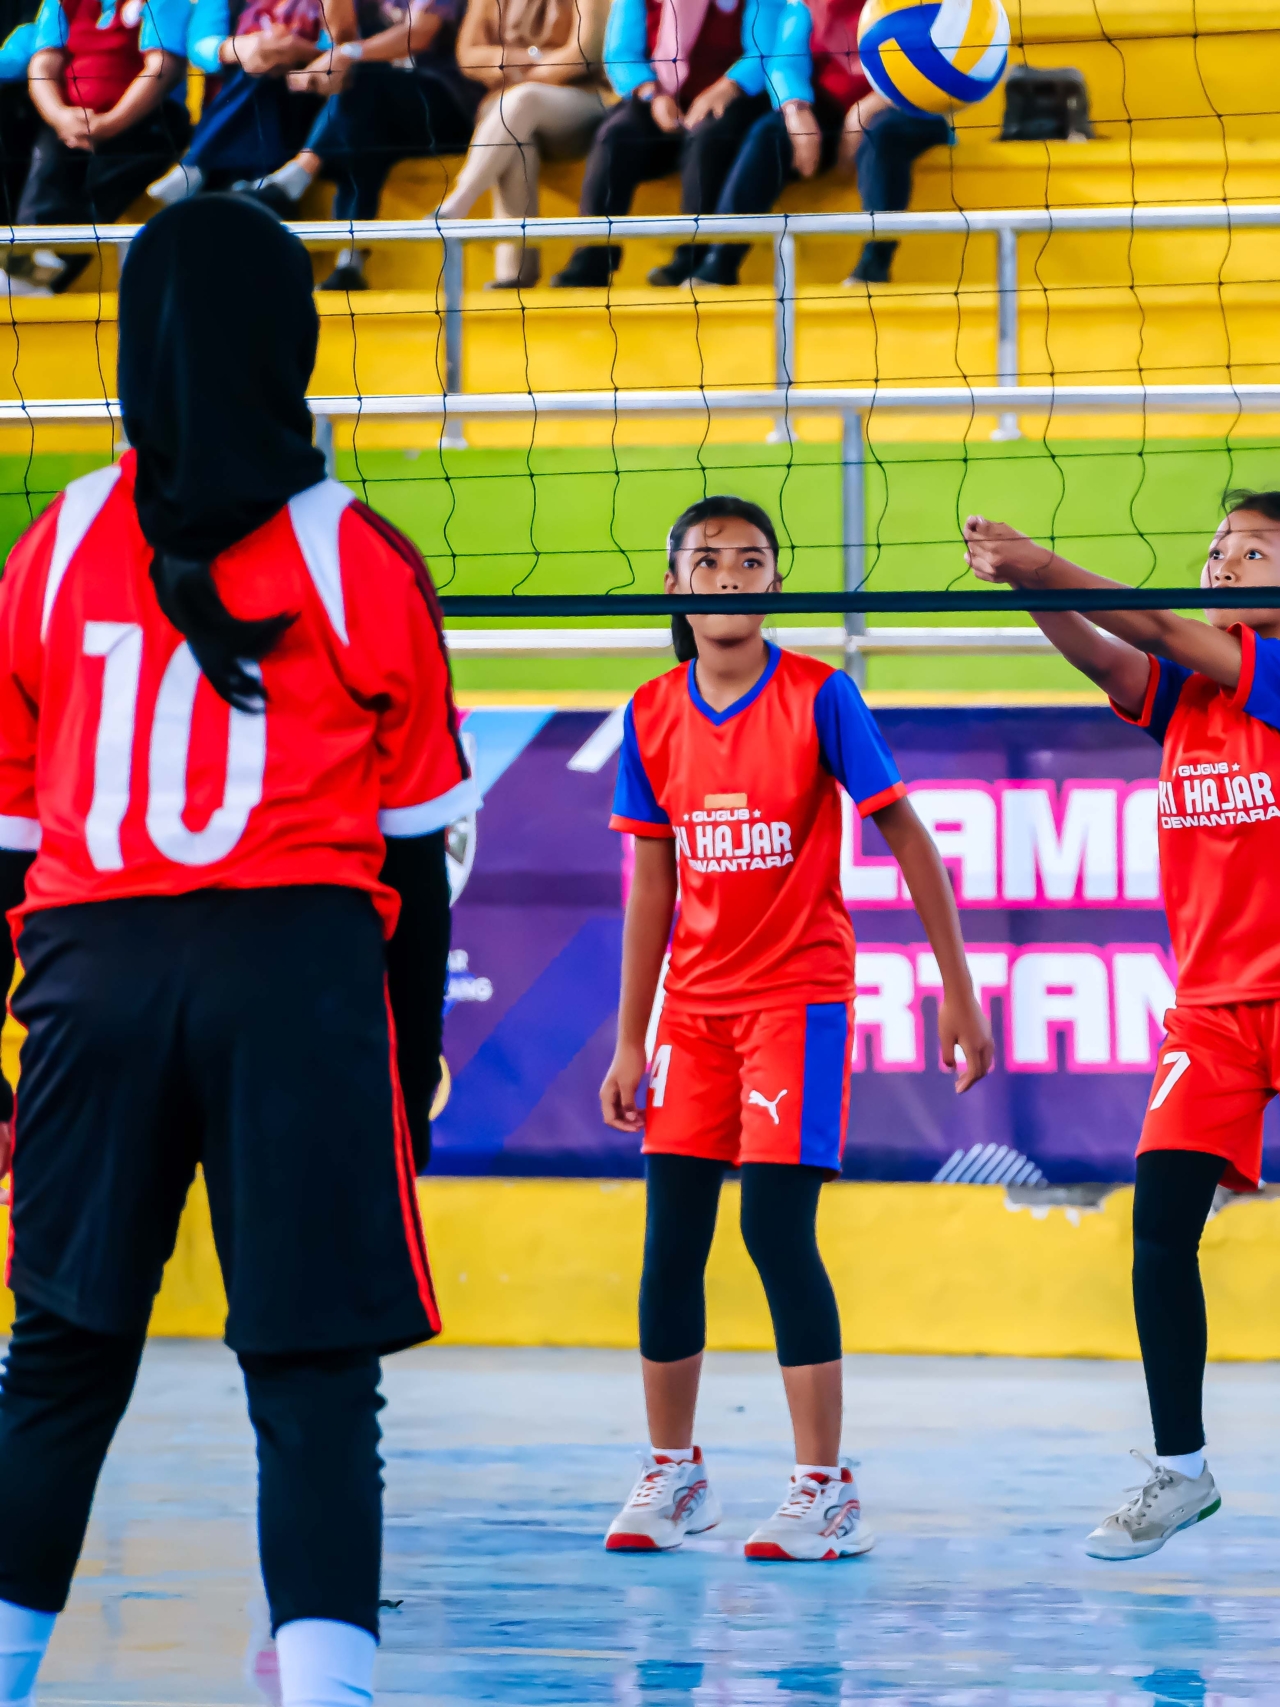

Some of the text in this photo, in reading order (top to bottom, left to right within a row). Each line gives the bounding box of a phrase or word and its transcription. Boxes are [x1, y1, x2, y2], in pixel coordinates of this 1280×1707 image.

[83, 621, 267, 872] 10
[1178, 762, 1229, 777] GUGUS
[1158, 772, 1275, 815] KI HAJAR
[692, 808, 750, 823] GUGUS
[696, 821, 792, 858] HAJAR
[649, 1044, 673, 1107] 4
[1149, 1051, 1191, 1111] 7
